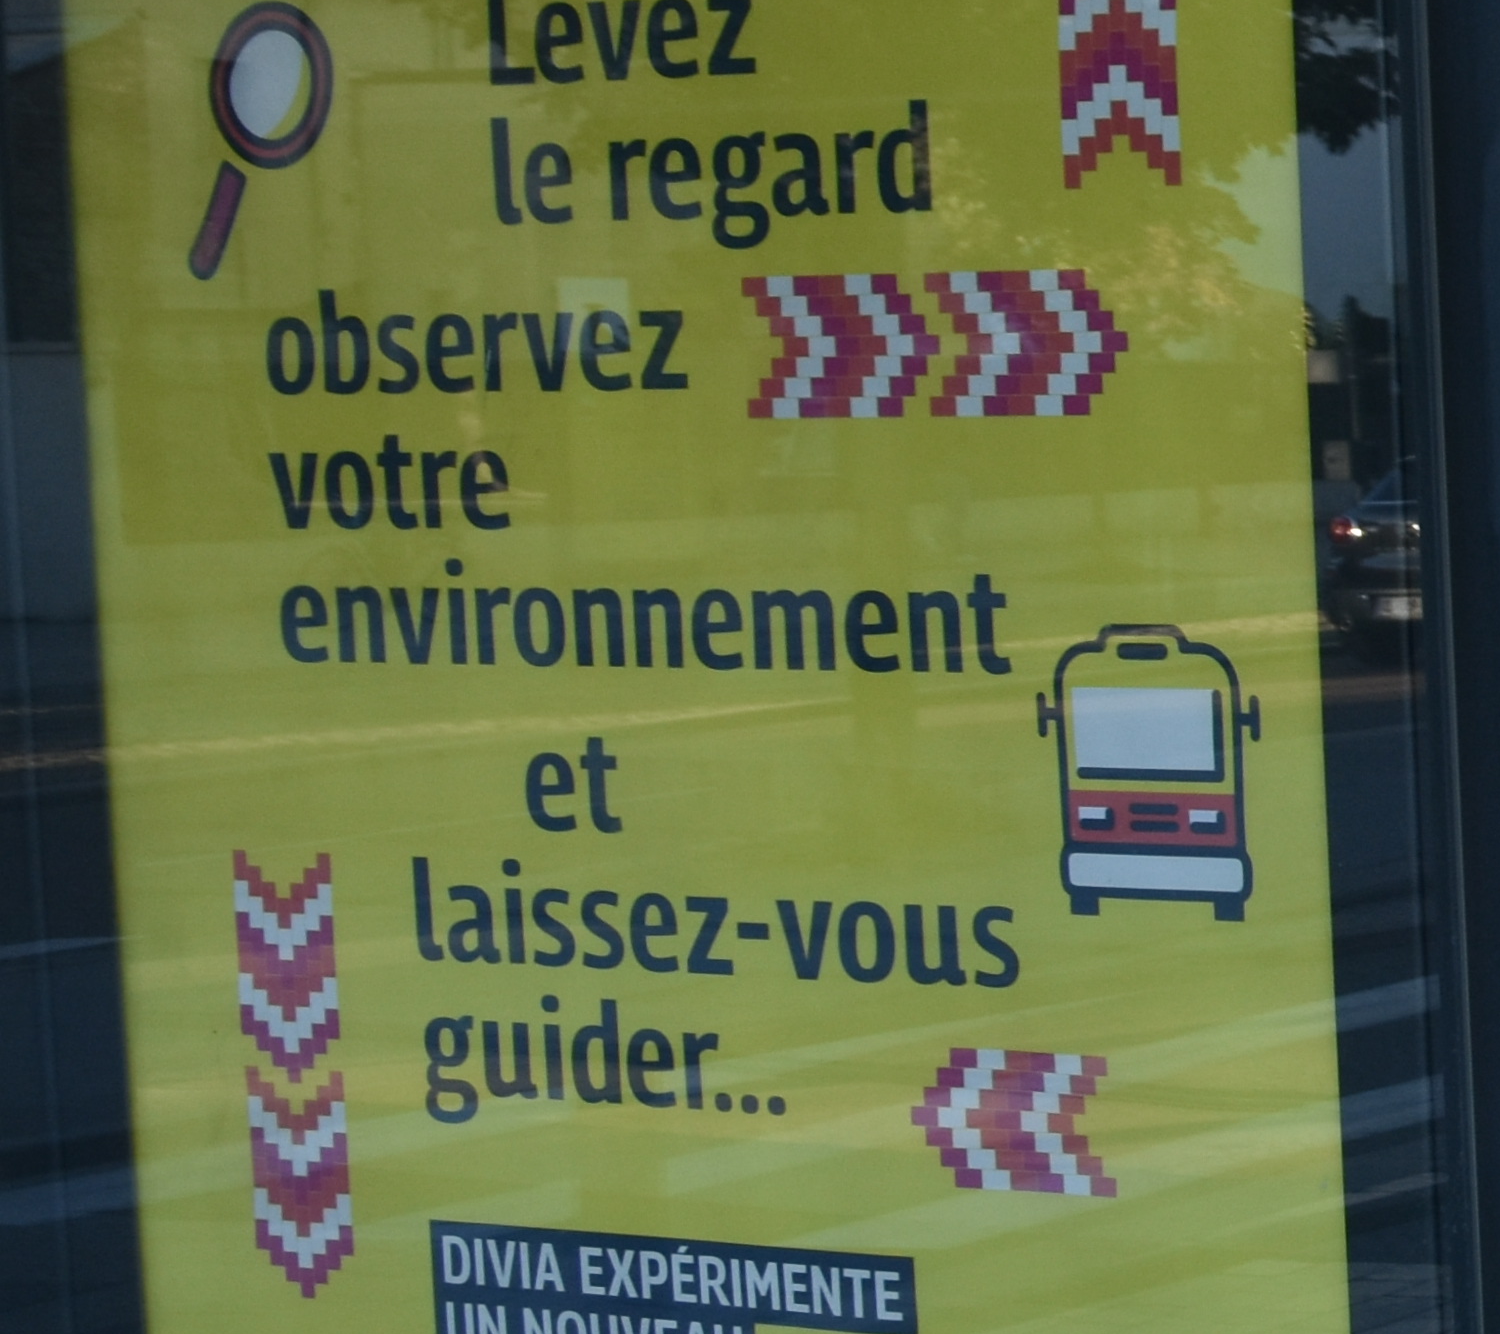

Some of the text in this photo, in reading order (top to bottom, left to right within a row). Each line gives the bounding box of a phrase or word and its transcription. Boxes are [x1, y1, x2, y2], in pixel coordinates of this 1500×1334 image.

[489, 100, 933, 250] le regard
[265, 289, 689, 395] observez
[268, 434, 511, 531] votre
[279, 559, 1012, 674] environnement
[524, 737, 622, 834] et
[410, 856, 1021, 989] laissez-vous
[422, 993, 788, 1124] guider...
[442, 1235, 902, 1322] DIVIA EXPÉRIMENTE
